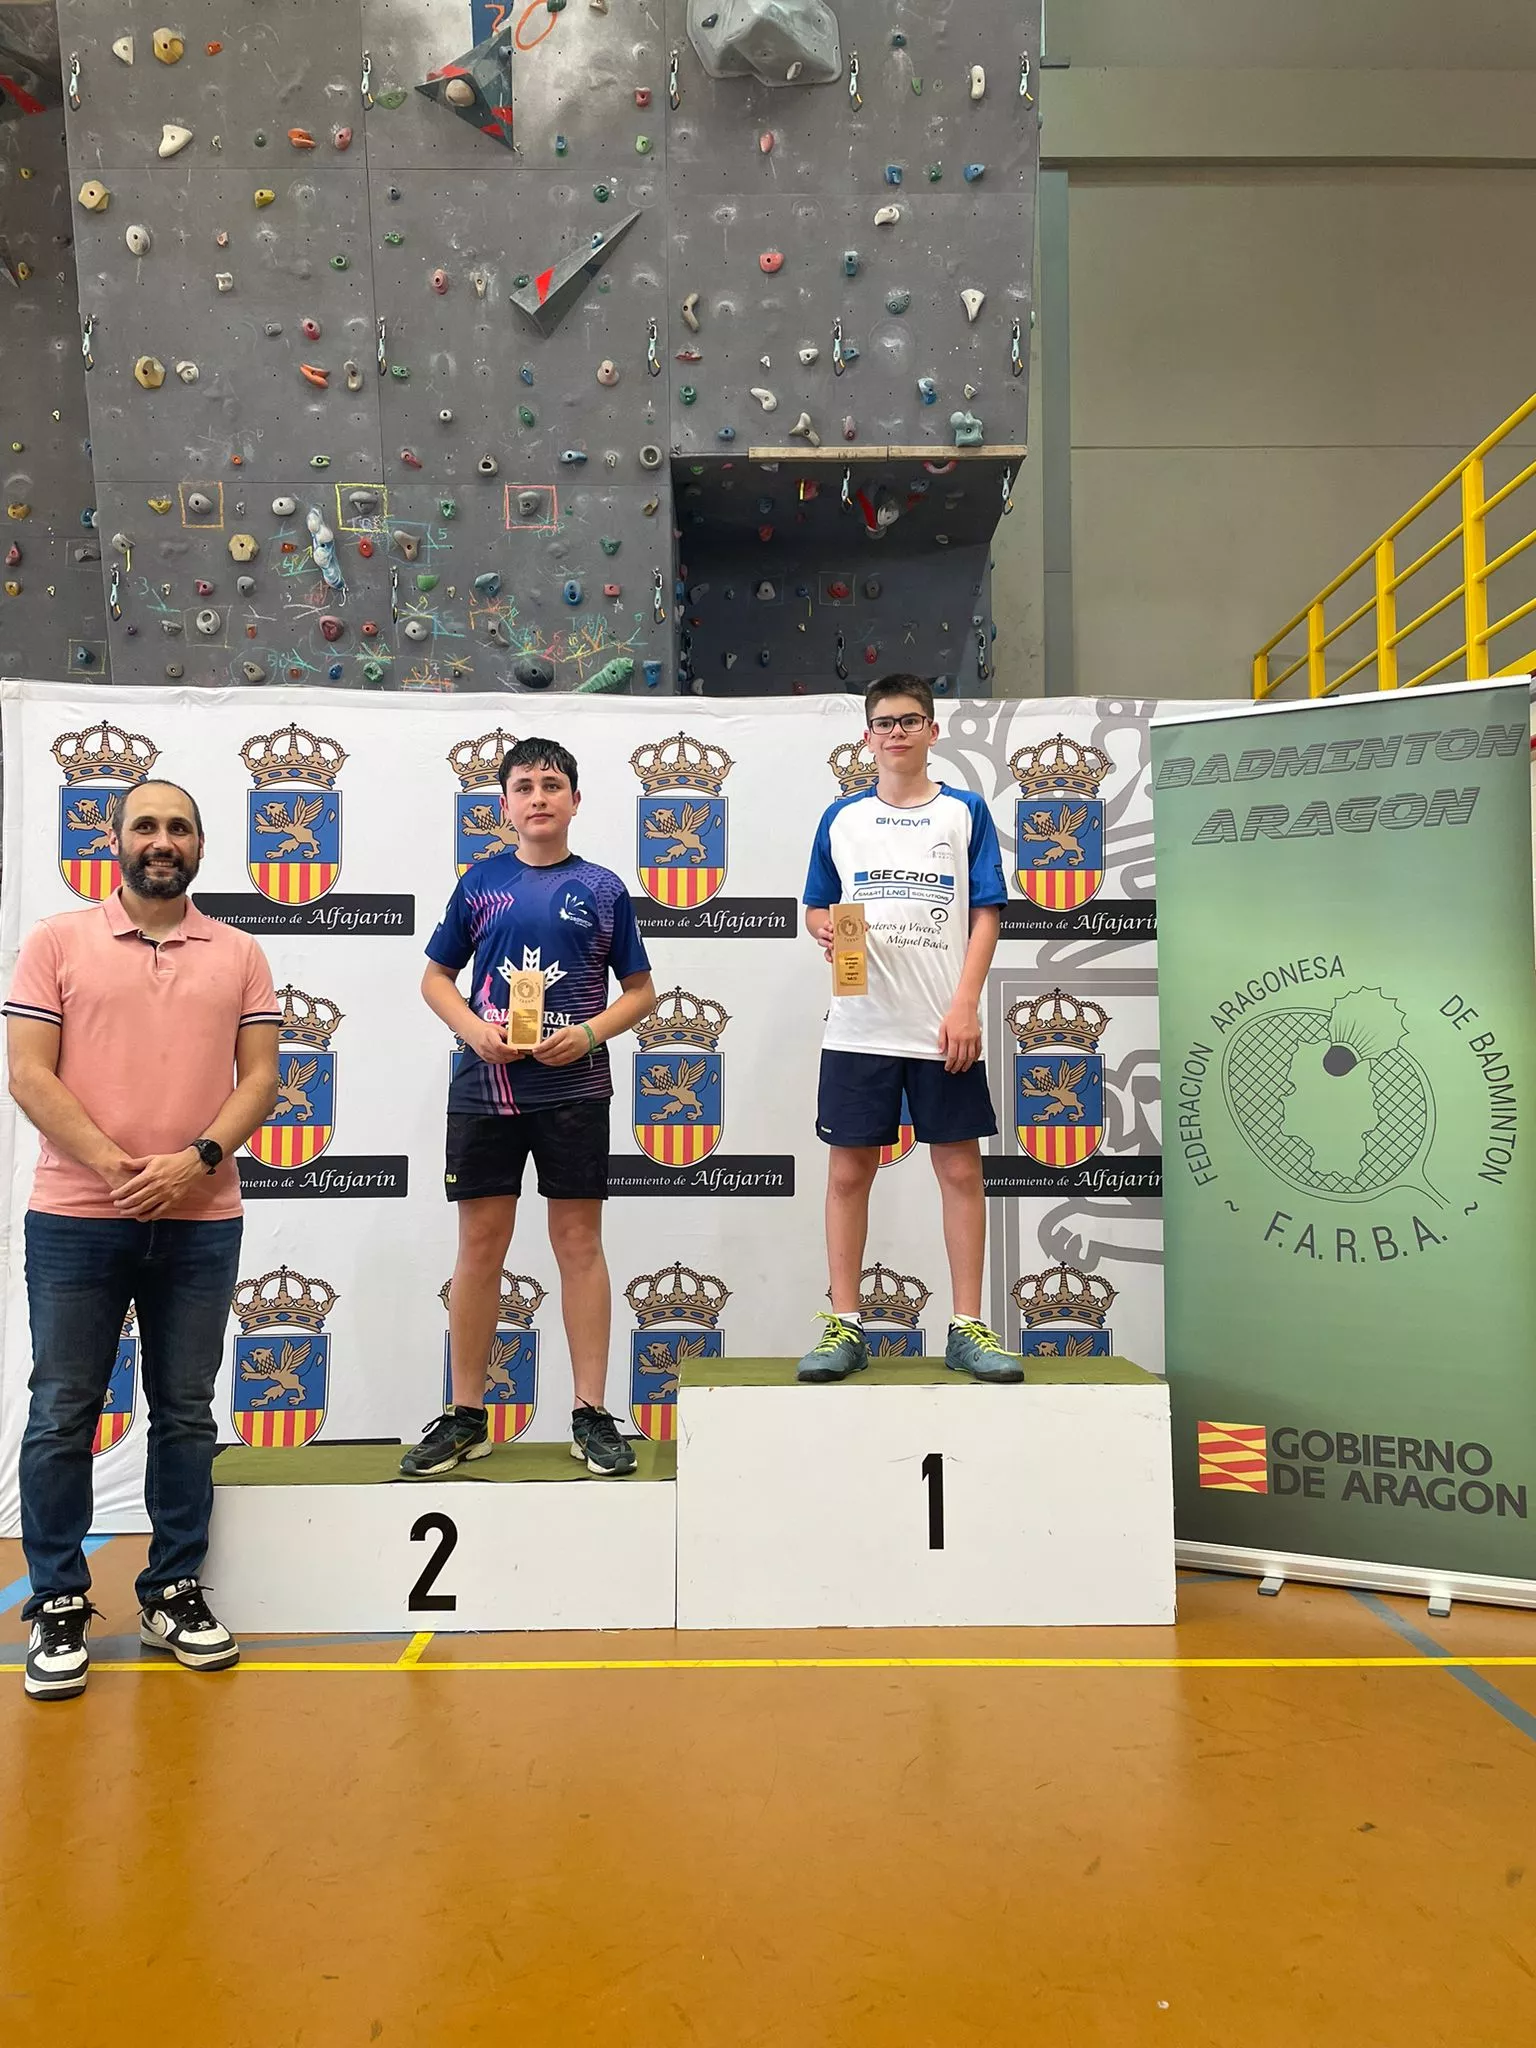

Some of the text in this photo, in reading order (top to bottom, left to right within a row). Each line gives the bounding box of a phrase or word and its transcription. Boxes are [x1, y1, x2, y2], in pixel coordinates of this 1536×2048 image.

[1155, 723, 1527, 790] BADMINTON
[875, 816, 931, 828] GIVOVA
[1191, 786, 1481, 845] ARAGON
[870, 869, 939, 884] GECRIO
[911, 891, 950, 902] SOLUTIONS
[204, 906, 405, 930] untamiento de Alfajarín
[677, 916, 691, 928] de
[694, 910, 787, 933] Alfajarín
[909, 922, 941, 934] Viveros
[1000, 919, 1054, 929] ntamiento
[1055, 919, 1069, 930] de
[886, 935, 922, 948] Miguel
[543, 1011, 574, 1026] RAL
[1178, 955, 1518, 1187] FEDERACION ARAGONESA DE BADMINTON
[281, 1176, 295, 1188] de
[299, 1169, 397, 1193] Alfajarín
[607, 1168, 784, 1191] untamiento de Alfajarín
[983, 1177, 1054, 1189] yuntamiento
[1056, 1175, 1070, 1187] de
[1263, 1210, 1449, 1264] F.A.R.B.A.
[1271, 1426, 1493, 1477] GOBIERNO
[921, 1453, 945, 1550] 1
[1271, 1463, 1528, 1520] DE ARAGON
[408, 1512, 458, 1612] 2
